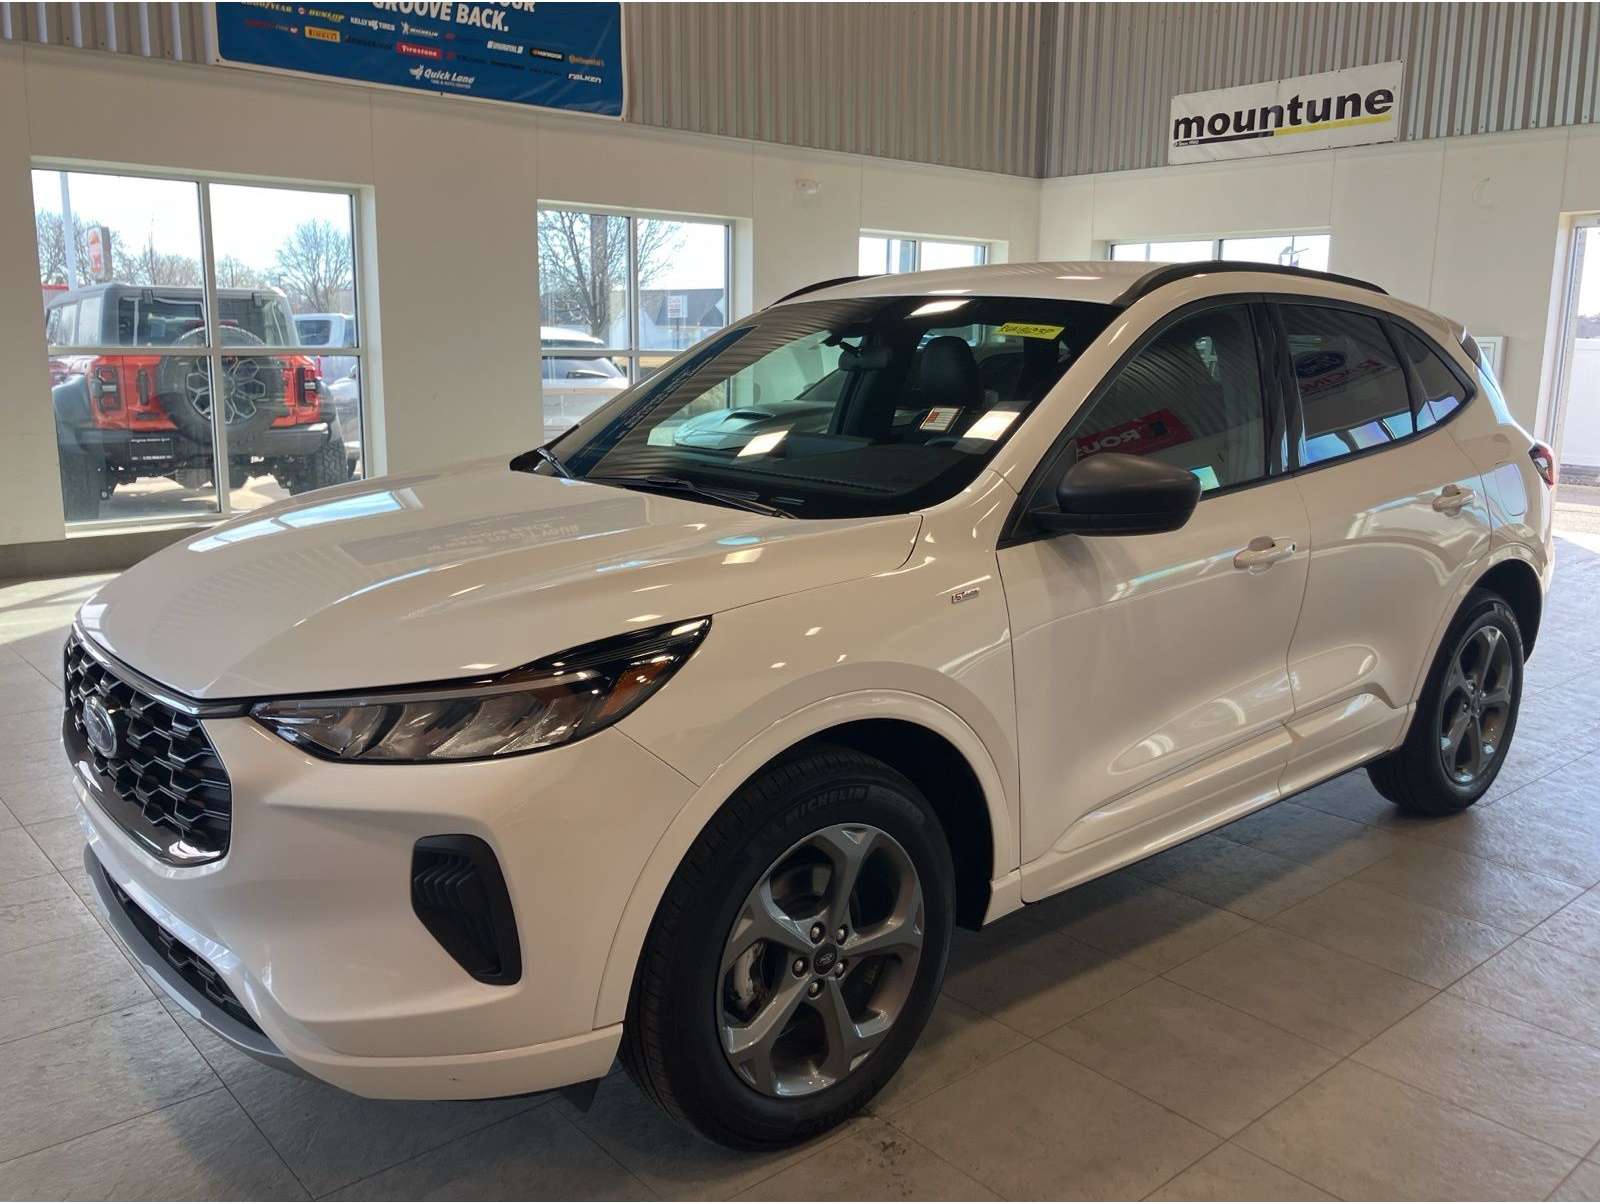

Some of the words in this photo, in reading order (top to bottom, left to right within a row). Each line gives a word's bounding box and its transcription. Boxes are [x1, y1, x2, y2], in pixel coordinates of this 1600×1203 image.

[455, 4, 510, 32] BACK.
[401, 43, 438, 57] Firestone
[424, 68, 450, 81] Quick
[568, 73, 602, 84] FALKEN
[1173, 88, 1394, 140] mountune
